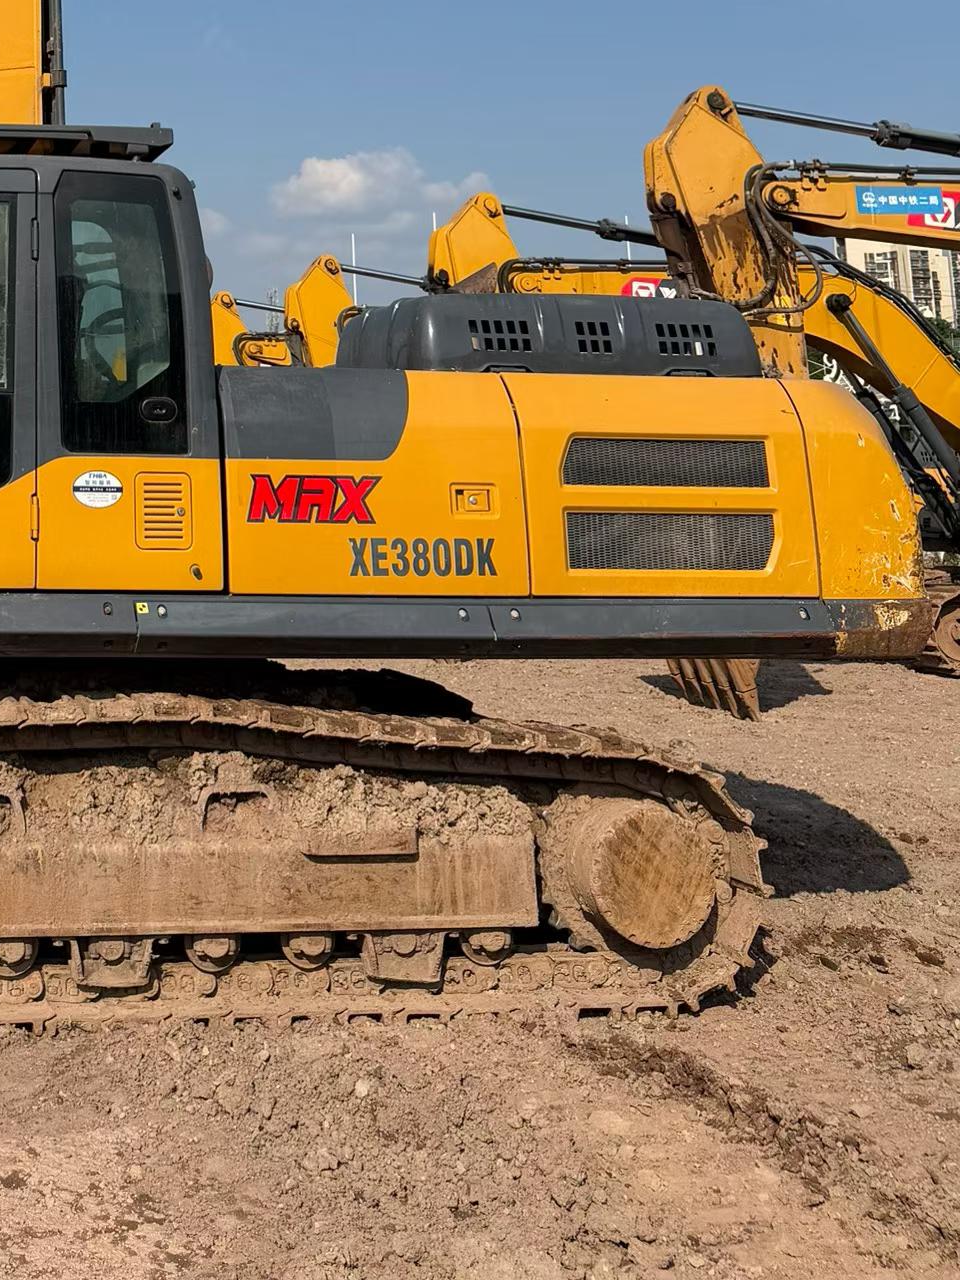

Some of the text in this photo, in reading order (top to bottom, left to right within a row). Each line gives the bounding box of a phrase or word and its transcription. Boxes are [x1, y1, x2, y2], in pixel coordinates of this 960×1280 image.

[878, 195, 939, 206] 中国中铁二局
[246, 474, 383, 524] MAX
[348, 538, 498, 577] XE380DK
